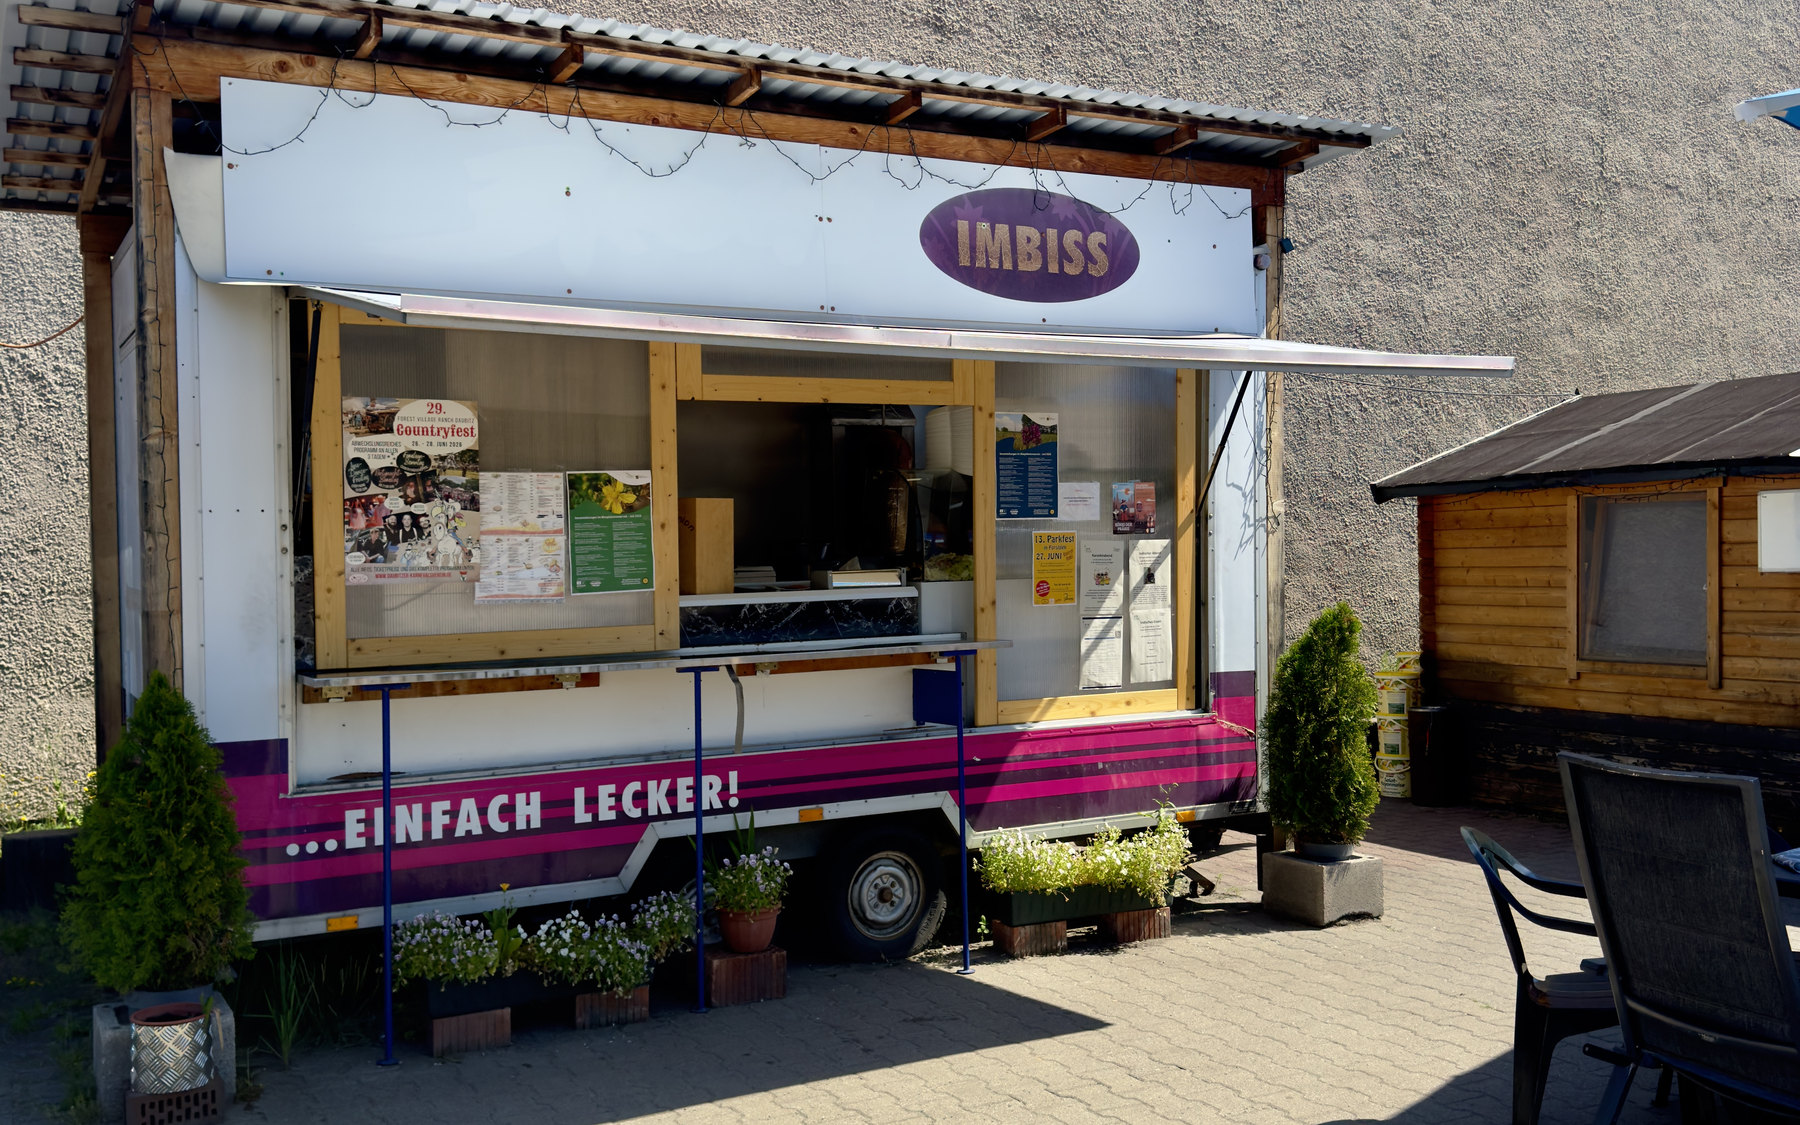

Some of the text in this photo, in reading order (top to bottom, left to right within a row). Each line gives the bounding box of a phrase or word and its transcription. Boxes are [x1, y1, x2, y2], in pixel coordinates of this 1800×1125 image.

[957, 219, 1109, 278] IMBISS
[426, 402, 446, 415] 29.
[396, 423, 477, 439] Countryfest
[1047, 535, 1074, 544] Parkfest
[286, 770, 740, 857] ...EINFACH LECKER!
